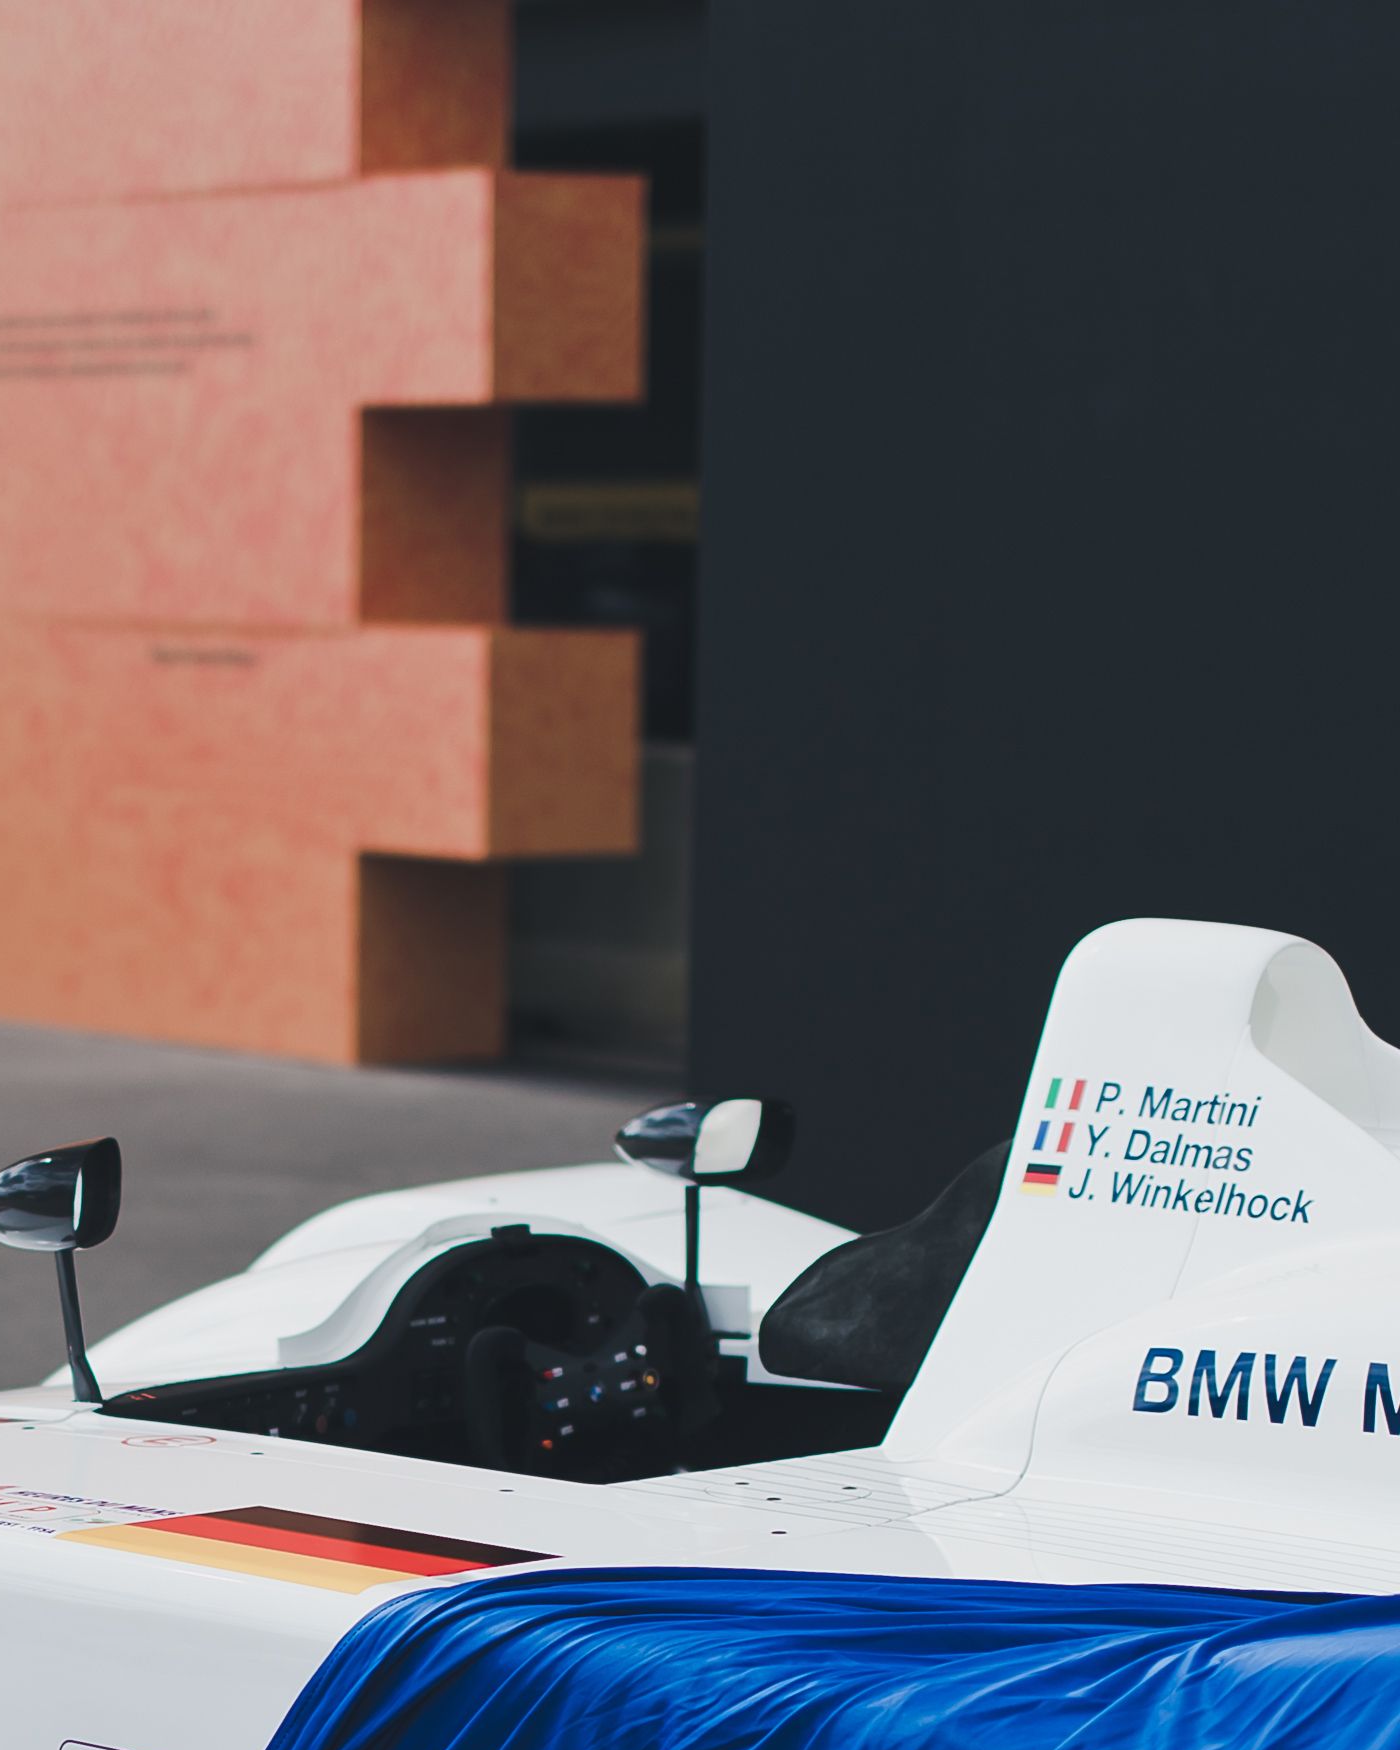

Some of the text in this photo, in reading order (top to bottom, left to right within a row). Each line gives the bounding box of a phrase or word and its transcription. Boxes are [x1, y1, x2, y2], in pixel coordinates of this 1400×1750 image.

[1095, 1081, 1262, 1128] P. Martini
[1087, 1123, 1254, 1173] Y. Dalmas
[1068, 1168, 1315, 1224] J. Winkelhock
[1132, 1346, 1338, 1428] BMW
